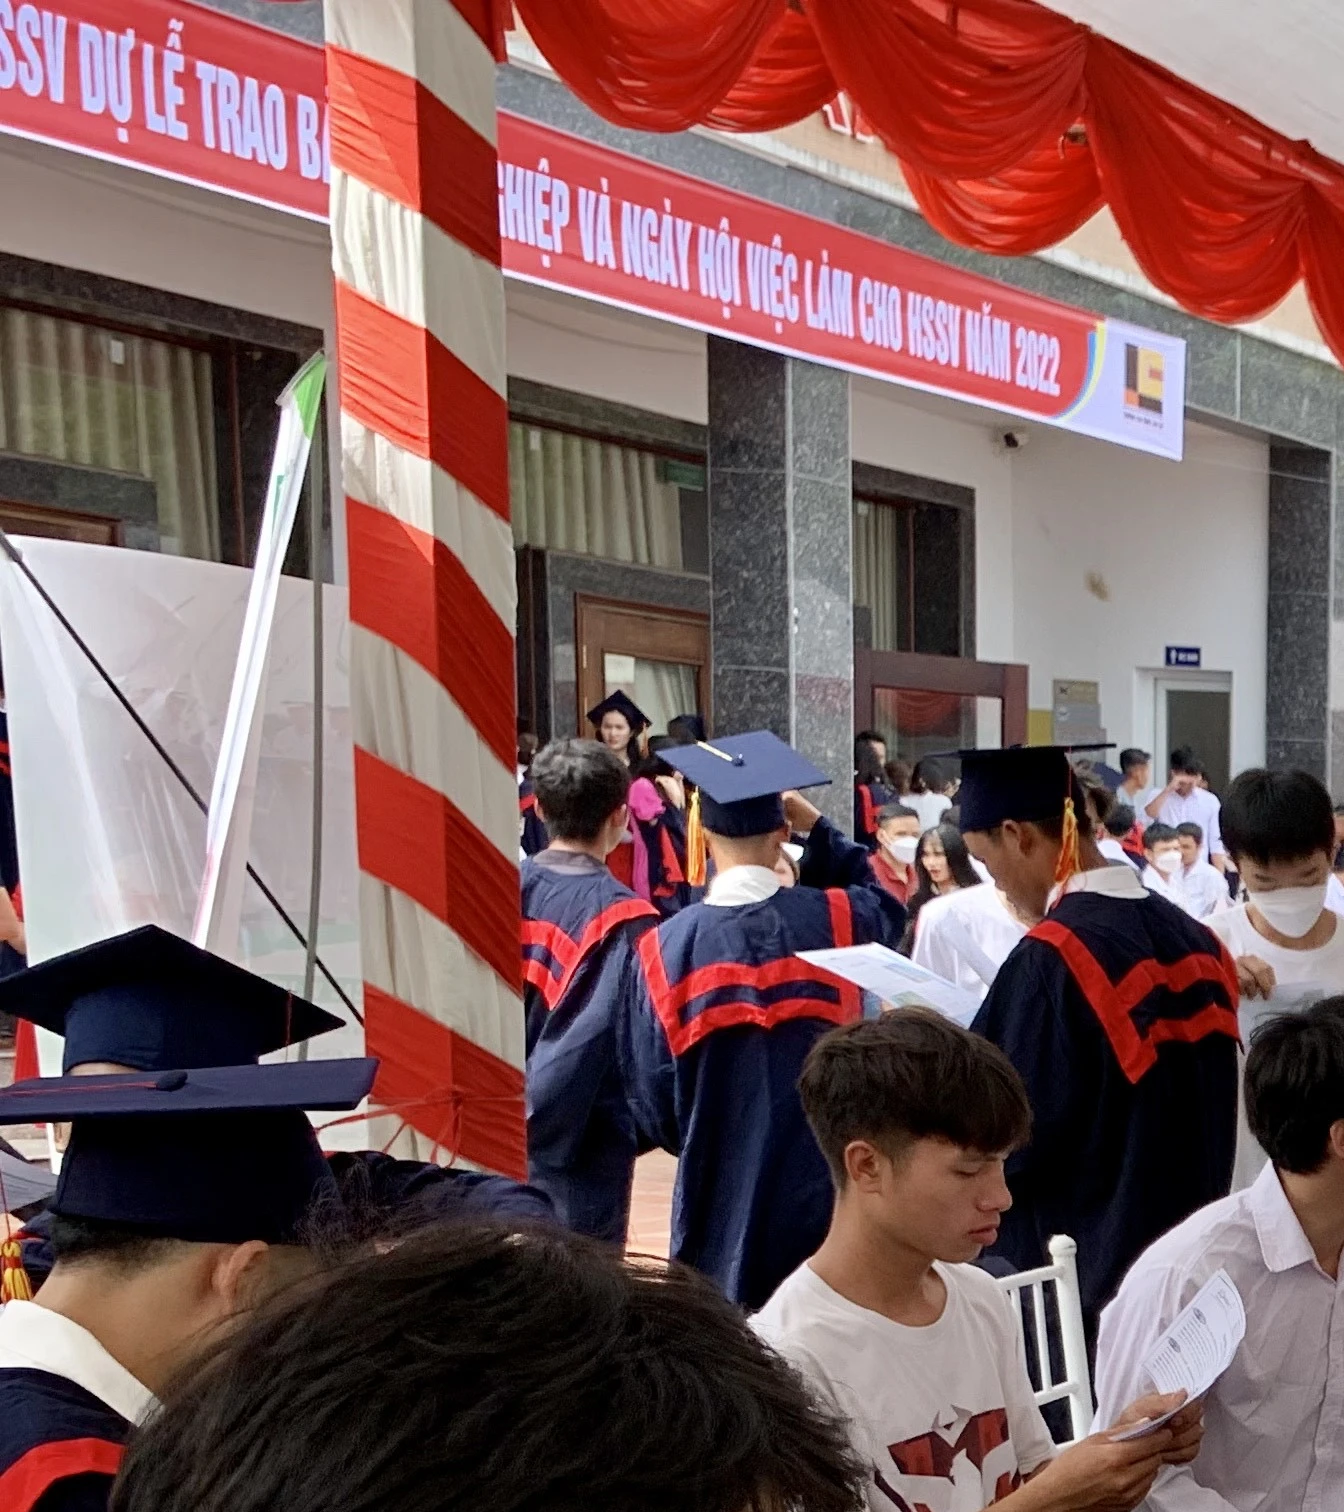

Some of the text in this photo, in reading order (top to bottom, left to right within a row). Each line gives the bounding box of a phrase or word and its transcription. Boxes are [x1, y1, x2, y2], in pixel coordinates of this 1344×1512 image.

[79, 22, 135, 143] DỰ
[142, 18, 188, 140] LỄ
[195, 60, 288, 170] TRAO
[578, 176, 617, 270] VÀ
[621, 198, 692, 291] NGÀY
[698, 216, 742, 320] HỘI
[746, 233, 800, 335] VIỆC
[804, 248, 855, 339] LÀM
[859, 277, 903, 353] CHO
[907, 291, 961, 368] HSSV
[965, 301, 1012, 383] NĂM
[1015, 326, 1061, 397] 2022
